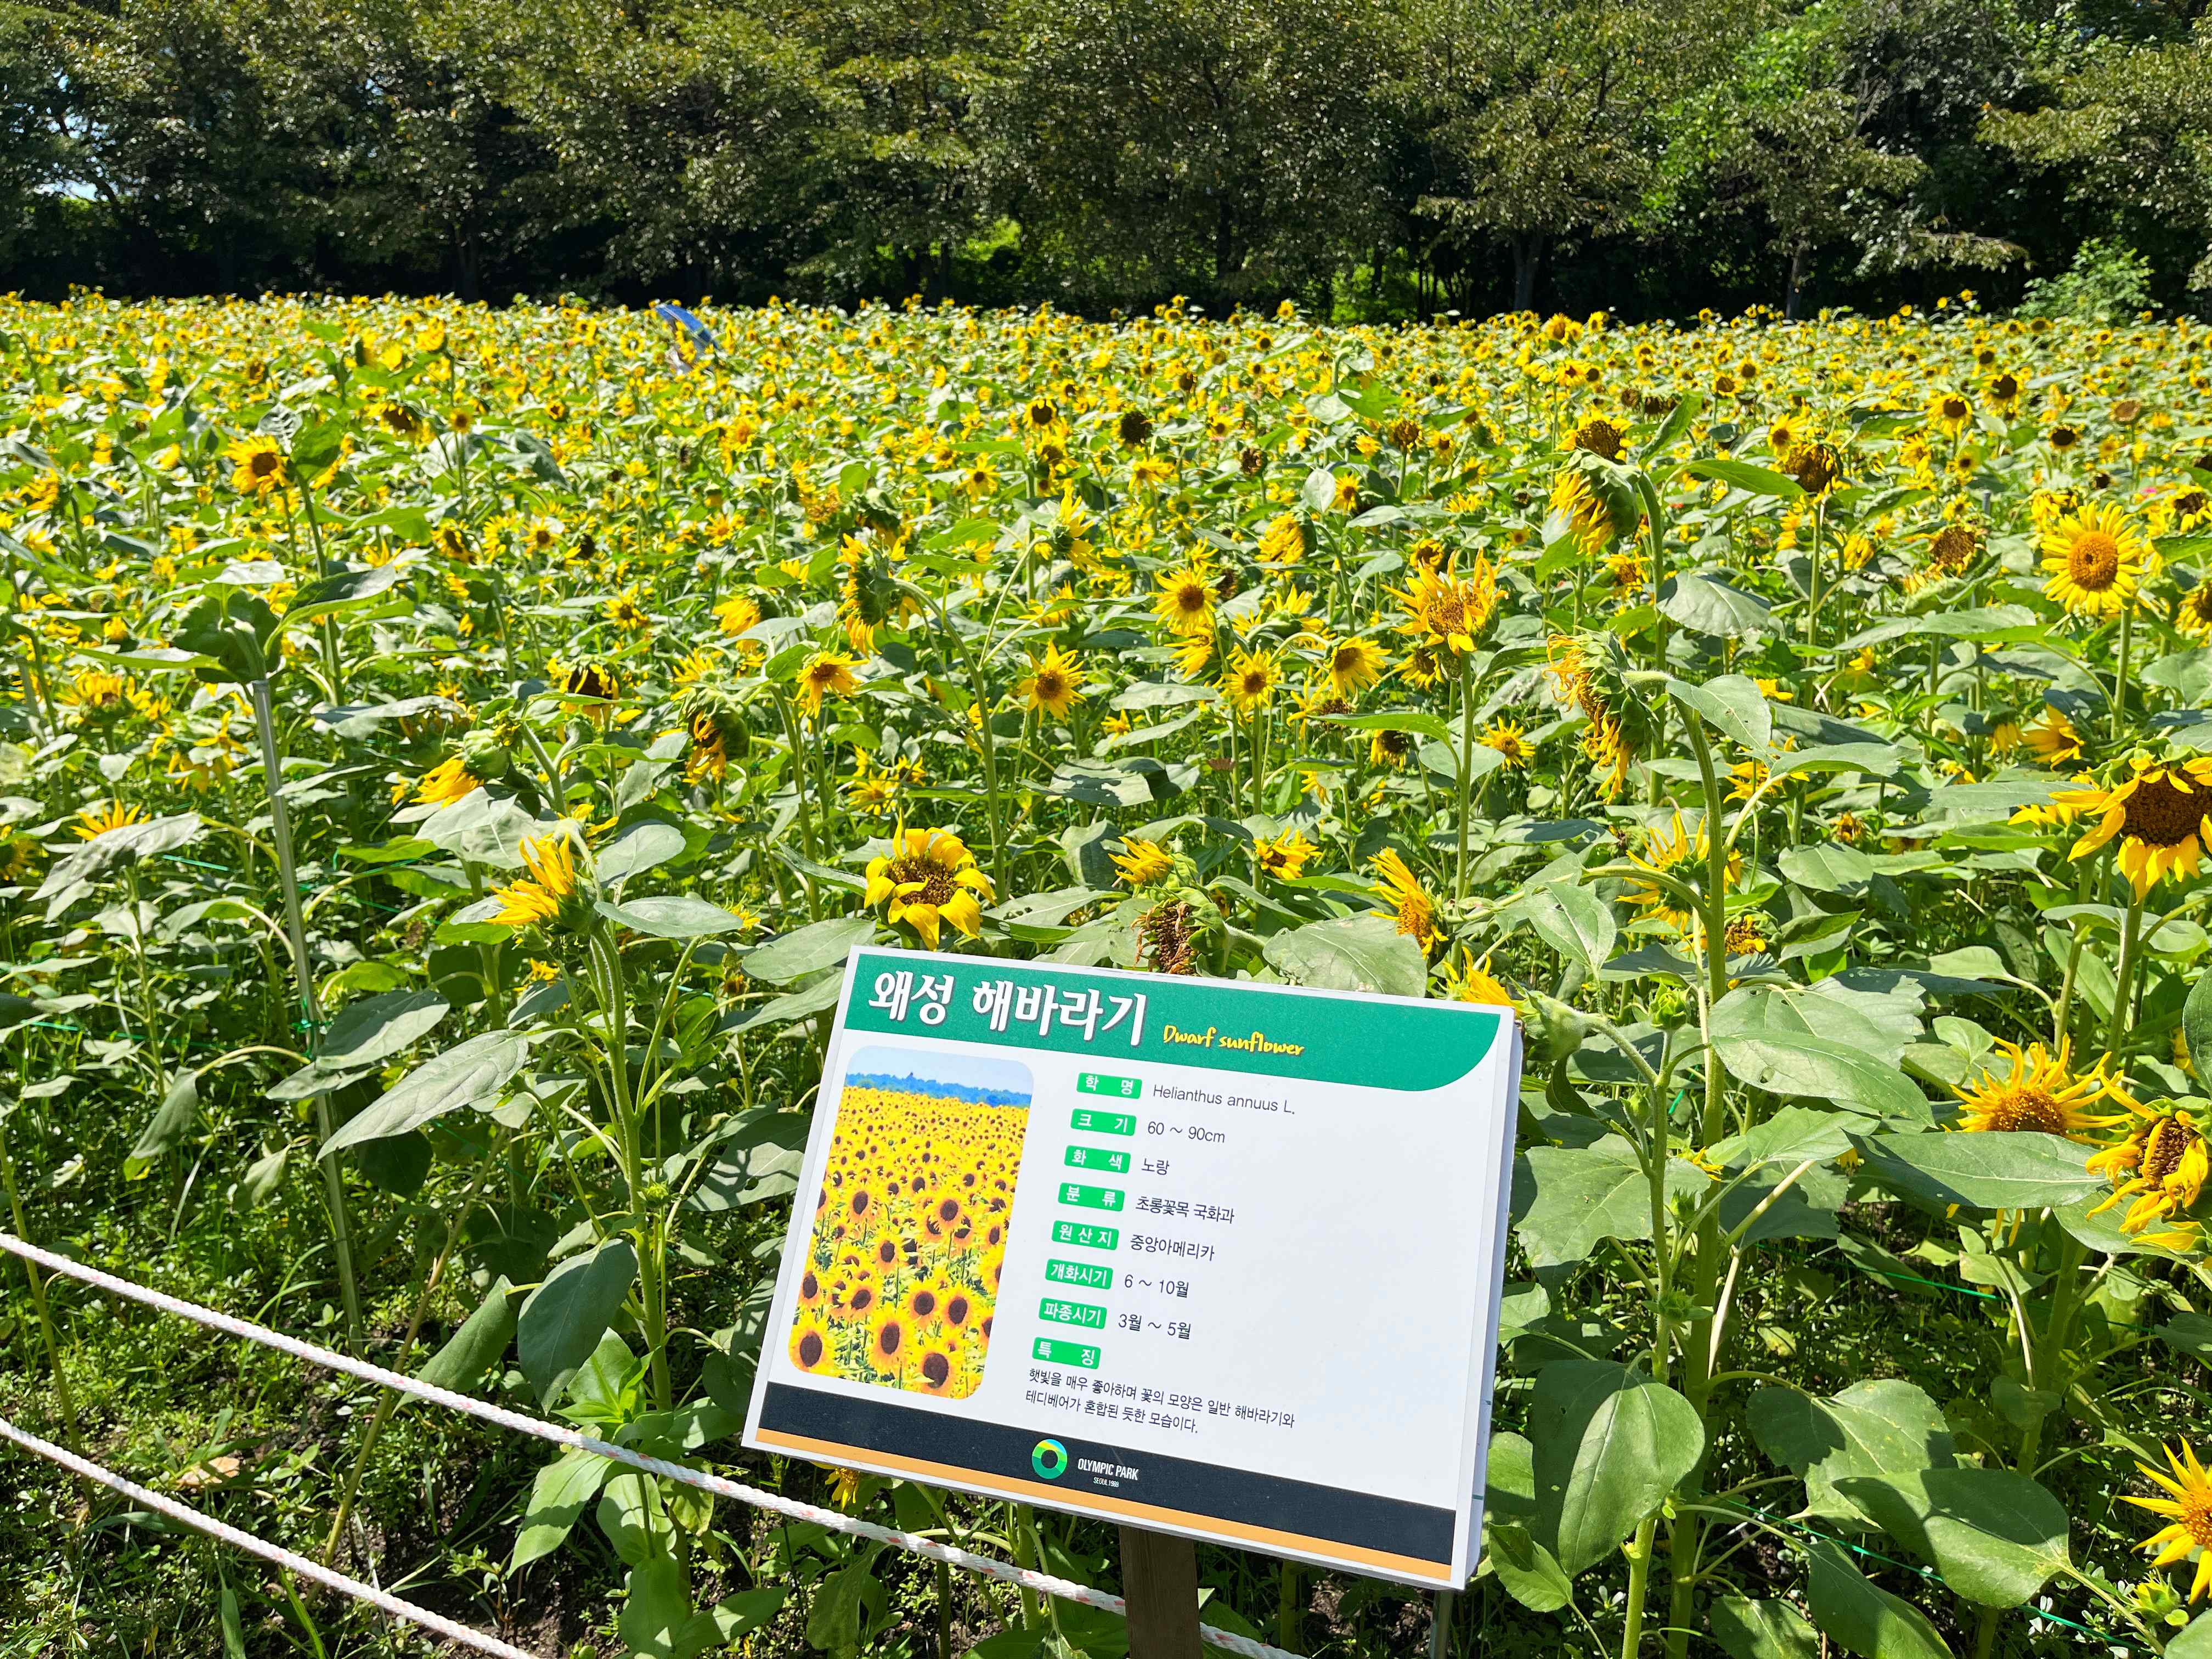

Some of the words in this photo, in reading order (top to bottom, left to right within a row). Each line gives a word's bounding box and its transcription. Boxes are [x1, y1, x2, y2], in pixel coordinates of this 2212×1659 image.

[868, 971, 954, 1024] 왜성
[972, 979, 1149, 1047] 해바라기
[1164, 1025, 1216, 1047] Dwarf
[1219, 1032, 1304, 1055] sunflower
[1154, 1085, 1222, 1104] Helianthus
[1228, 1097, 1277, 1111] annuus
[1284, 1101, 1294, 1114] L.
[1148, 1122, 1164, 1135] 60
[1188, 1127, 1224, 1143] 90cm
[1142, 1159, 1169, 1175] 노랑
[1136, 1197, 1189, 1217] 초롱꽃목
[1194, 1204, 1234, 1223] 국화과
[1131, 1235, 1214, 1261] 중앙아메리카
[1050, 1262, 1108, 1286] 개화시기
[1125, 1274, 1133, 1288] 6
[1160, 1280, 1188, 1297] 10월
[1043, 1301, 1102, 1326] 파종시기
[1119, 1314, 1141, 1331] 3월
[1167, 1322, 1190, 1339] 5월
[1030, 1369, 1062, 1386] 햇빛을
[1066, 1376, 1087, 1391] 매우
[1092, 1380, 1136, 1400] 좋아하며
[1141, 1389, 1164, 1404] 꽃의
[1167, 1395, 1203, 1411] 모양은
[1209, 1401, 1231, 1416] 일반
[1235, 1406, 1294, 1428] 해바라기와
[1026, 1391, 1081, 1412] 테디베어가
[1085, 1400, 1118, 1418] 혼합된
[1122, 1407, 1146, 1423] 듯한
[1149, 1413, 1197, 1433] 모습이다.
[1078, 1459, 1114, 1475] OLYMPIC
[1115, 1465, 1138, 1480] PARK
